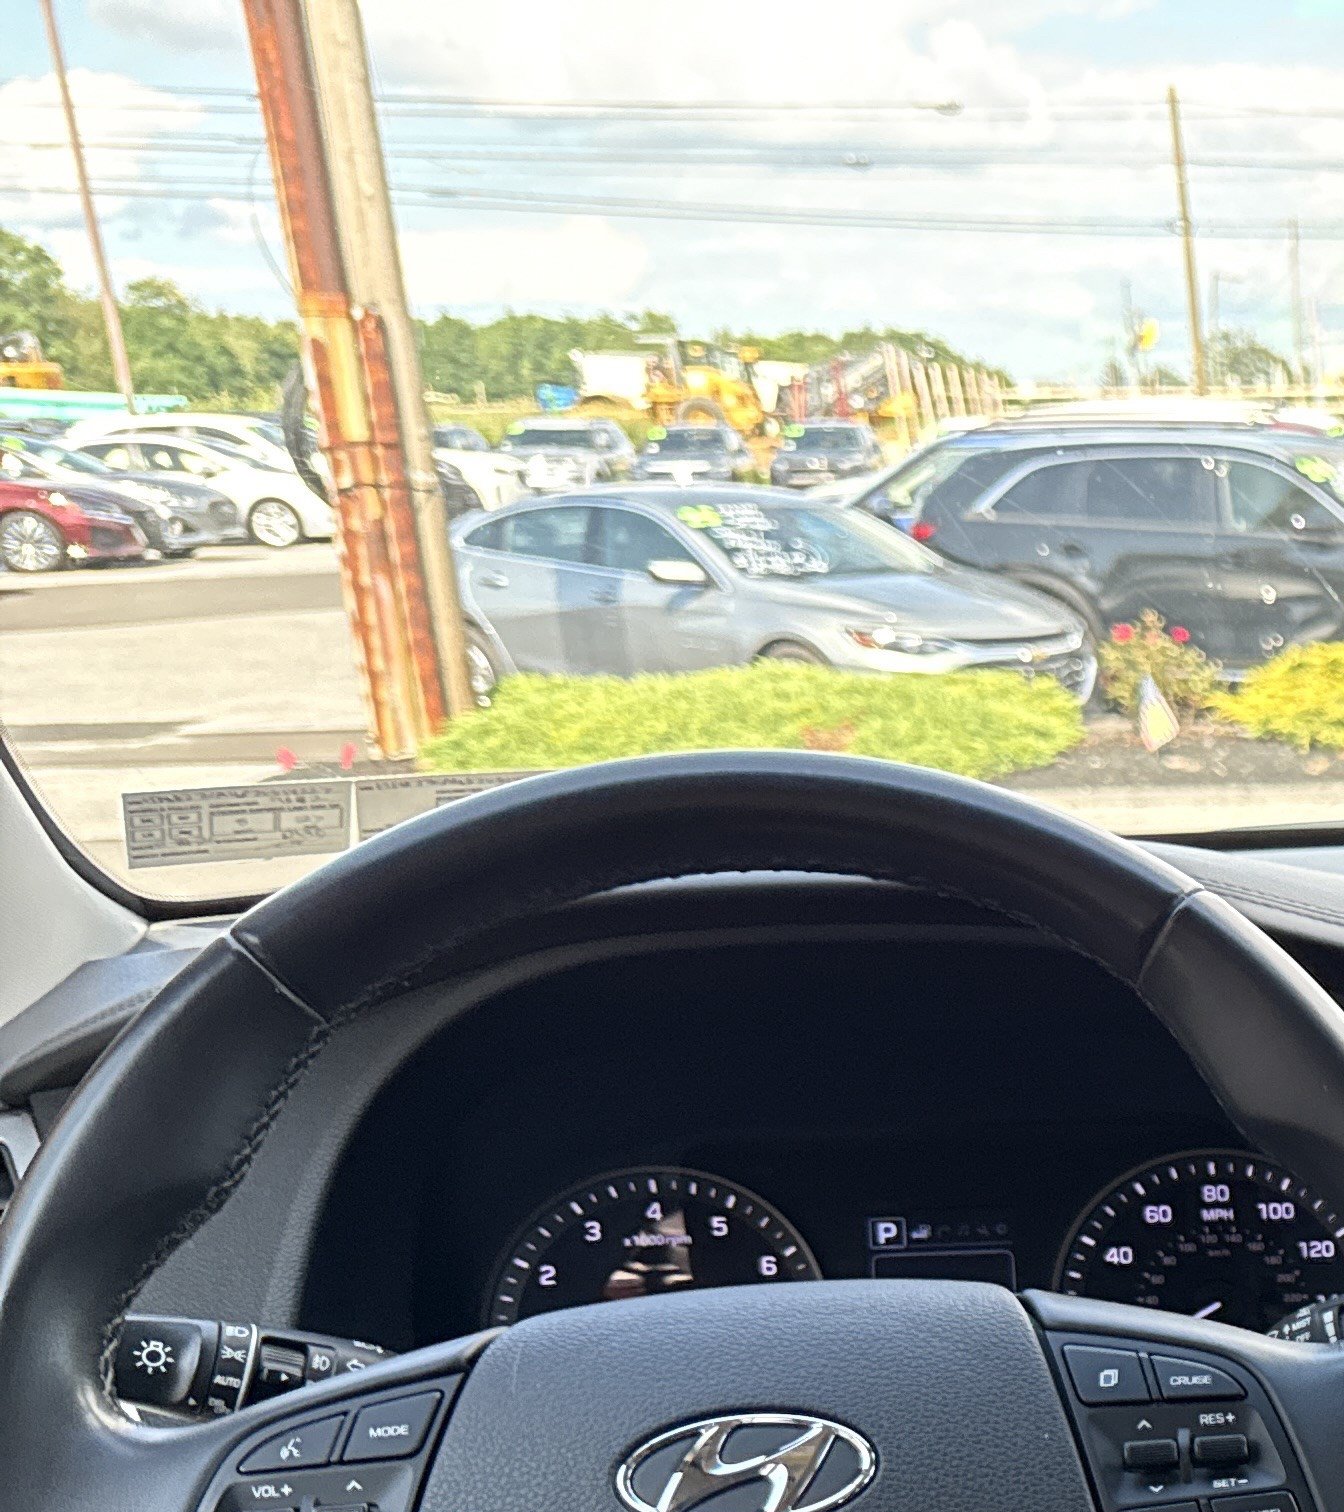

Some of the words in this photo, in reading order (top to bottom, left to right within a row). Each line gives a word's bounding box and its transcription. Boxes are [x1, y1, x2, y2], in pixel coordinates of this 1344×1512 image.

[1201, 1184, 1230, 1203] 80
[645, 1202, 663, 1221] 4
[1144, 1204, 1173, 1224] 60
[1201, 1207, 1235, 1221] MPH
[1257, 1201, 1296, 1221] 100
[584, 1220, 602, 1242] 3
[710, 1214, 729, 1237] 5
[878, 1221, 898, 1244] P
[1104, 1245, 1134, 1265] 40
[1299, 1239, 1335, 1259] 120
[760, 1254, 779, 1276] 6
[538, 1264, 557, 1287] 2
[1169, 1374, 1213, 1387] CRUISE
[368, 1424, 410, 1438] MODE
